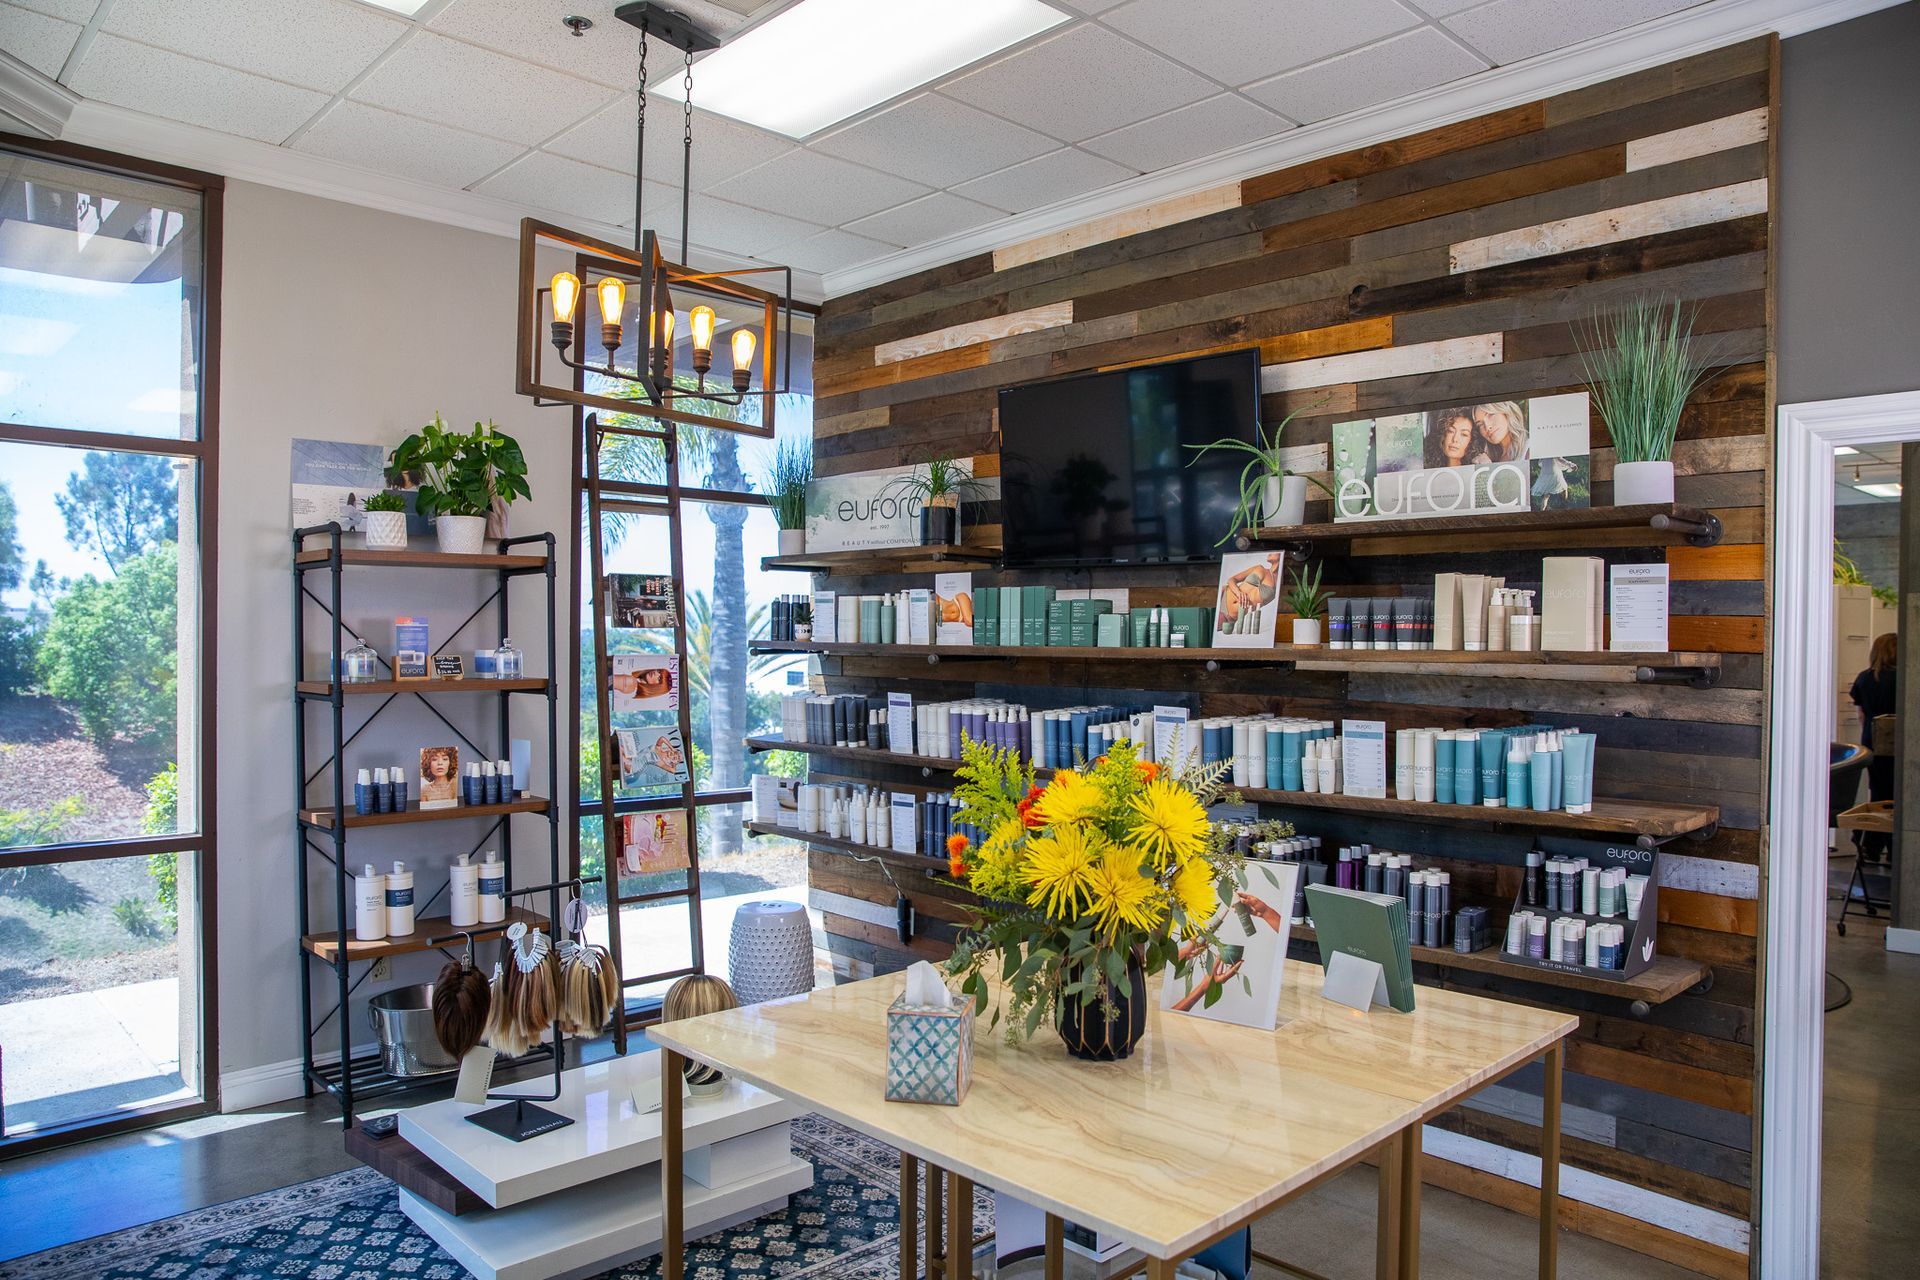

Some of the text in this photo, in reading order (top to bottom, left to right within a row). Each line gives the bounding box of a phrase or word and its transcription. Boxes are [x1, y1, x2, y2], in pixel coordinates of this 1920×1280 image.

[1338, 464, 1527, 519] eufora
[400, 667, 425, 675] eufora
[668, 728, 688, 782] VOE
[1606, 847, 1652, 862] eufora
[1563, 965, 1582, 973] TRAVEL
